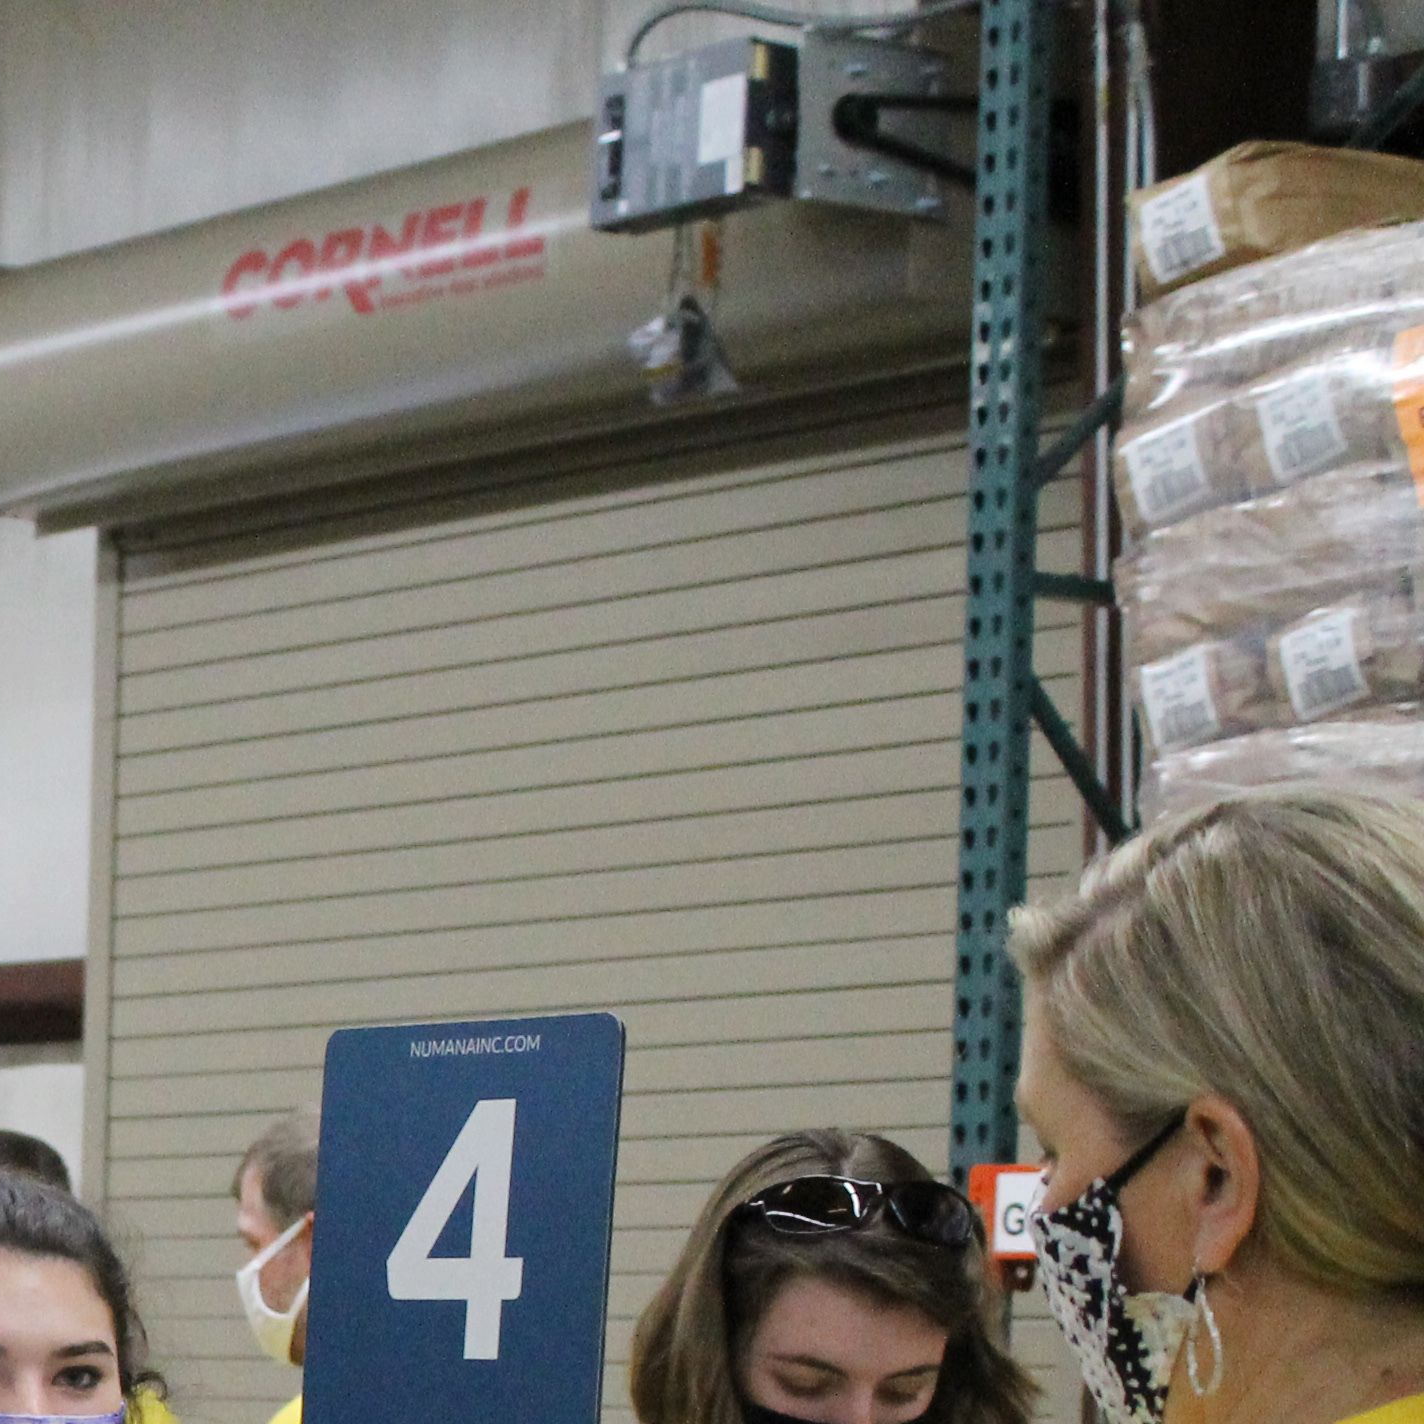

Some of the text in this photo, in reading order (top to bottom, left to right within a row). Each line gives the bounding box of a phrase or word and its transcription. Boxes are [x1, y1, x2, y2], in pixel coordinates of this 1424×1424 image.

[222, 186, 545, 320] CORNELL
[410, 1034, 541, 1057] NUMANAINC.COM
[386, 1098, 524, 1361] 4
